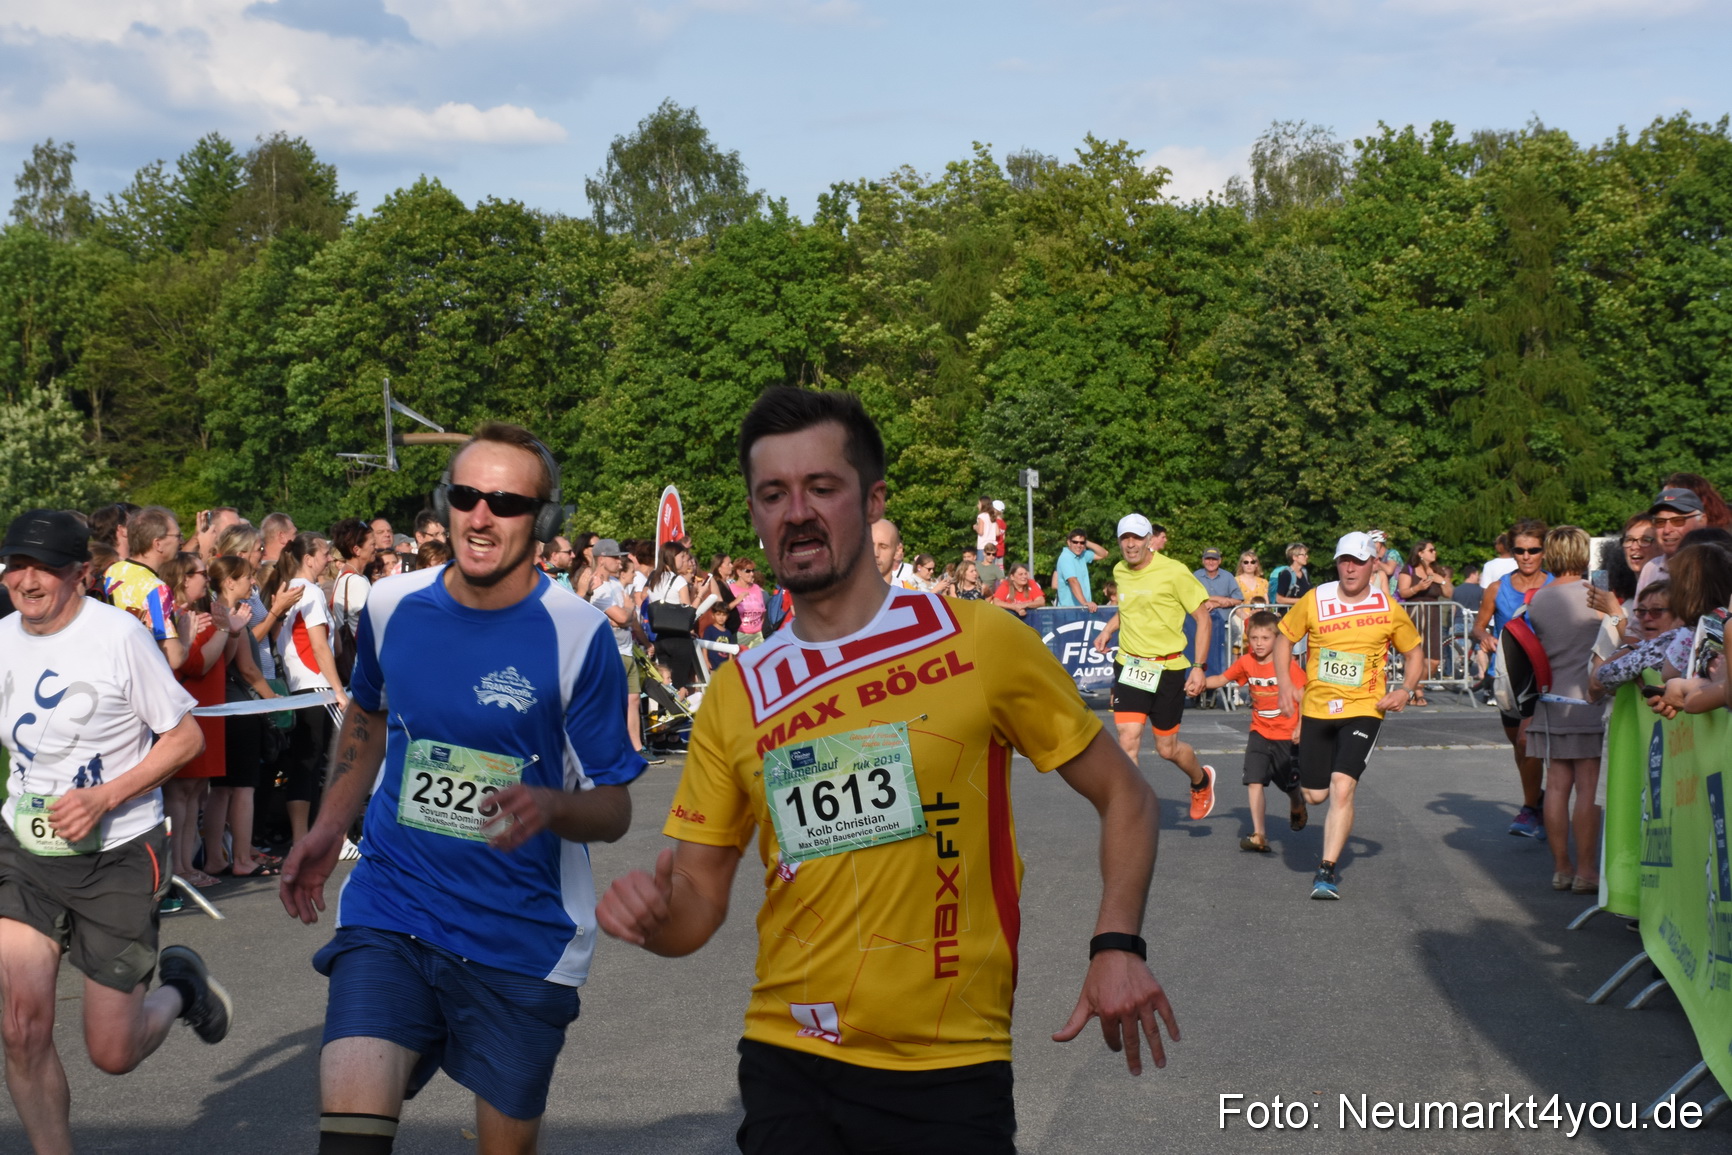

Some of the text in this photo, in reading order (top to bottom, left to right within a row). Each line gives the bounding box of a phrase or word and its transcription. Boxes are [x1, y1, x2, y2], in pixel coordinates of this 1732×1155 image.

[1319, 616, 1391, 634] MAX BÖGL
[1128, 667, 1155, 683] 1197
[1324, 661, 1357, 677] 1683
[756, 650, 975, 760] MAX BÖGL
[874, 753, 901, 767] 2019
[786, 768, 897, 827] 1613
[419, 806, 448, 819] Sovum
[806, 813, 886, 838] Kolb Christian
[798, 842, 813, 850] Max
[814, 838, 832, 847] Bögl
[833, 828, 874, 842] Bauservice
[875, 822, 900, 833] GmbH
